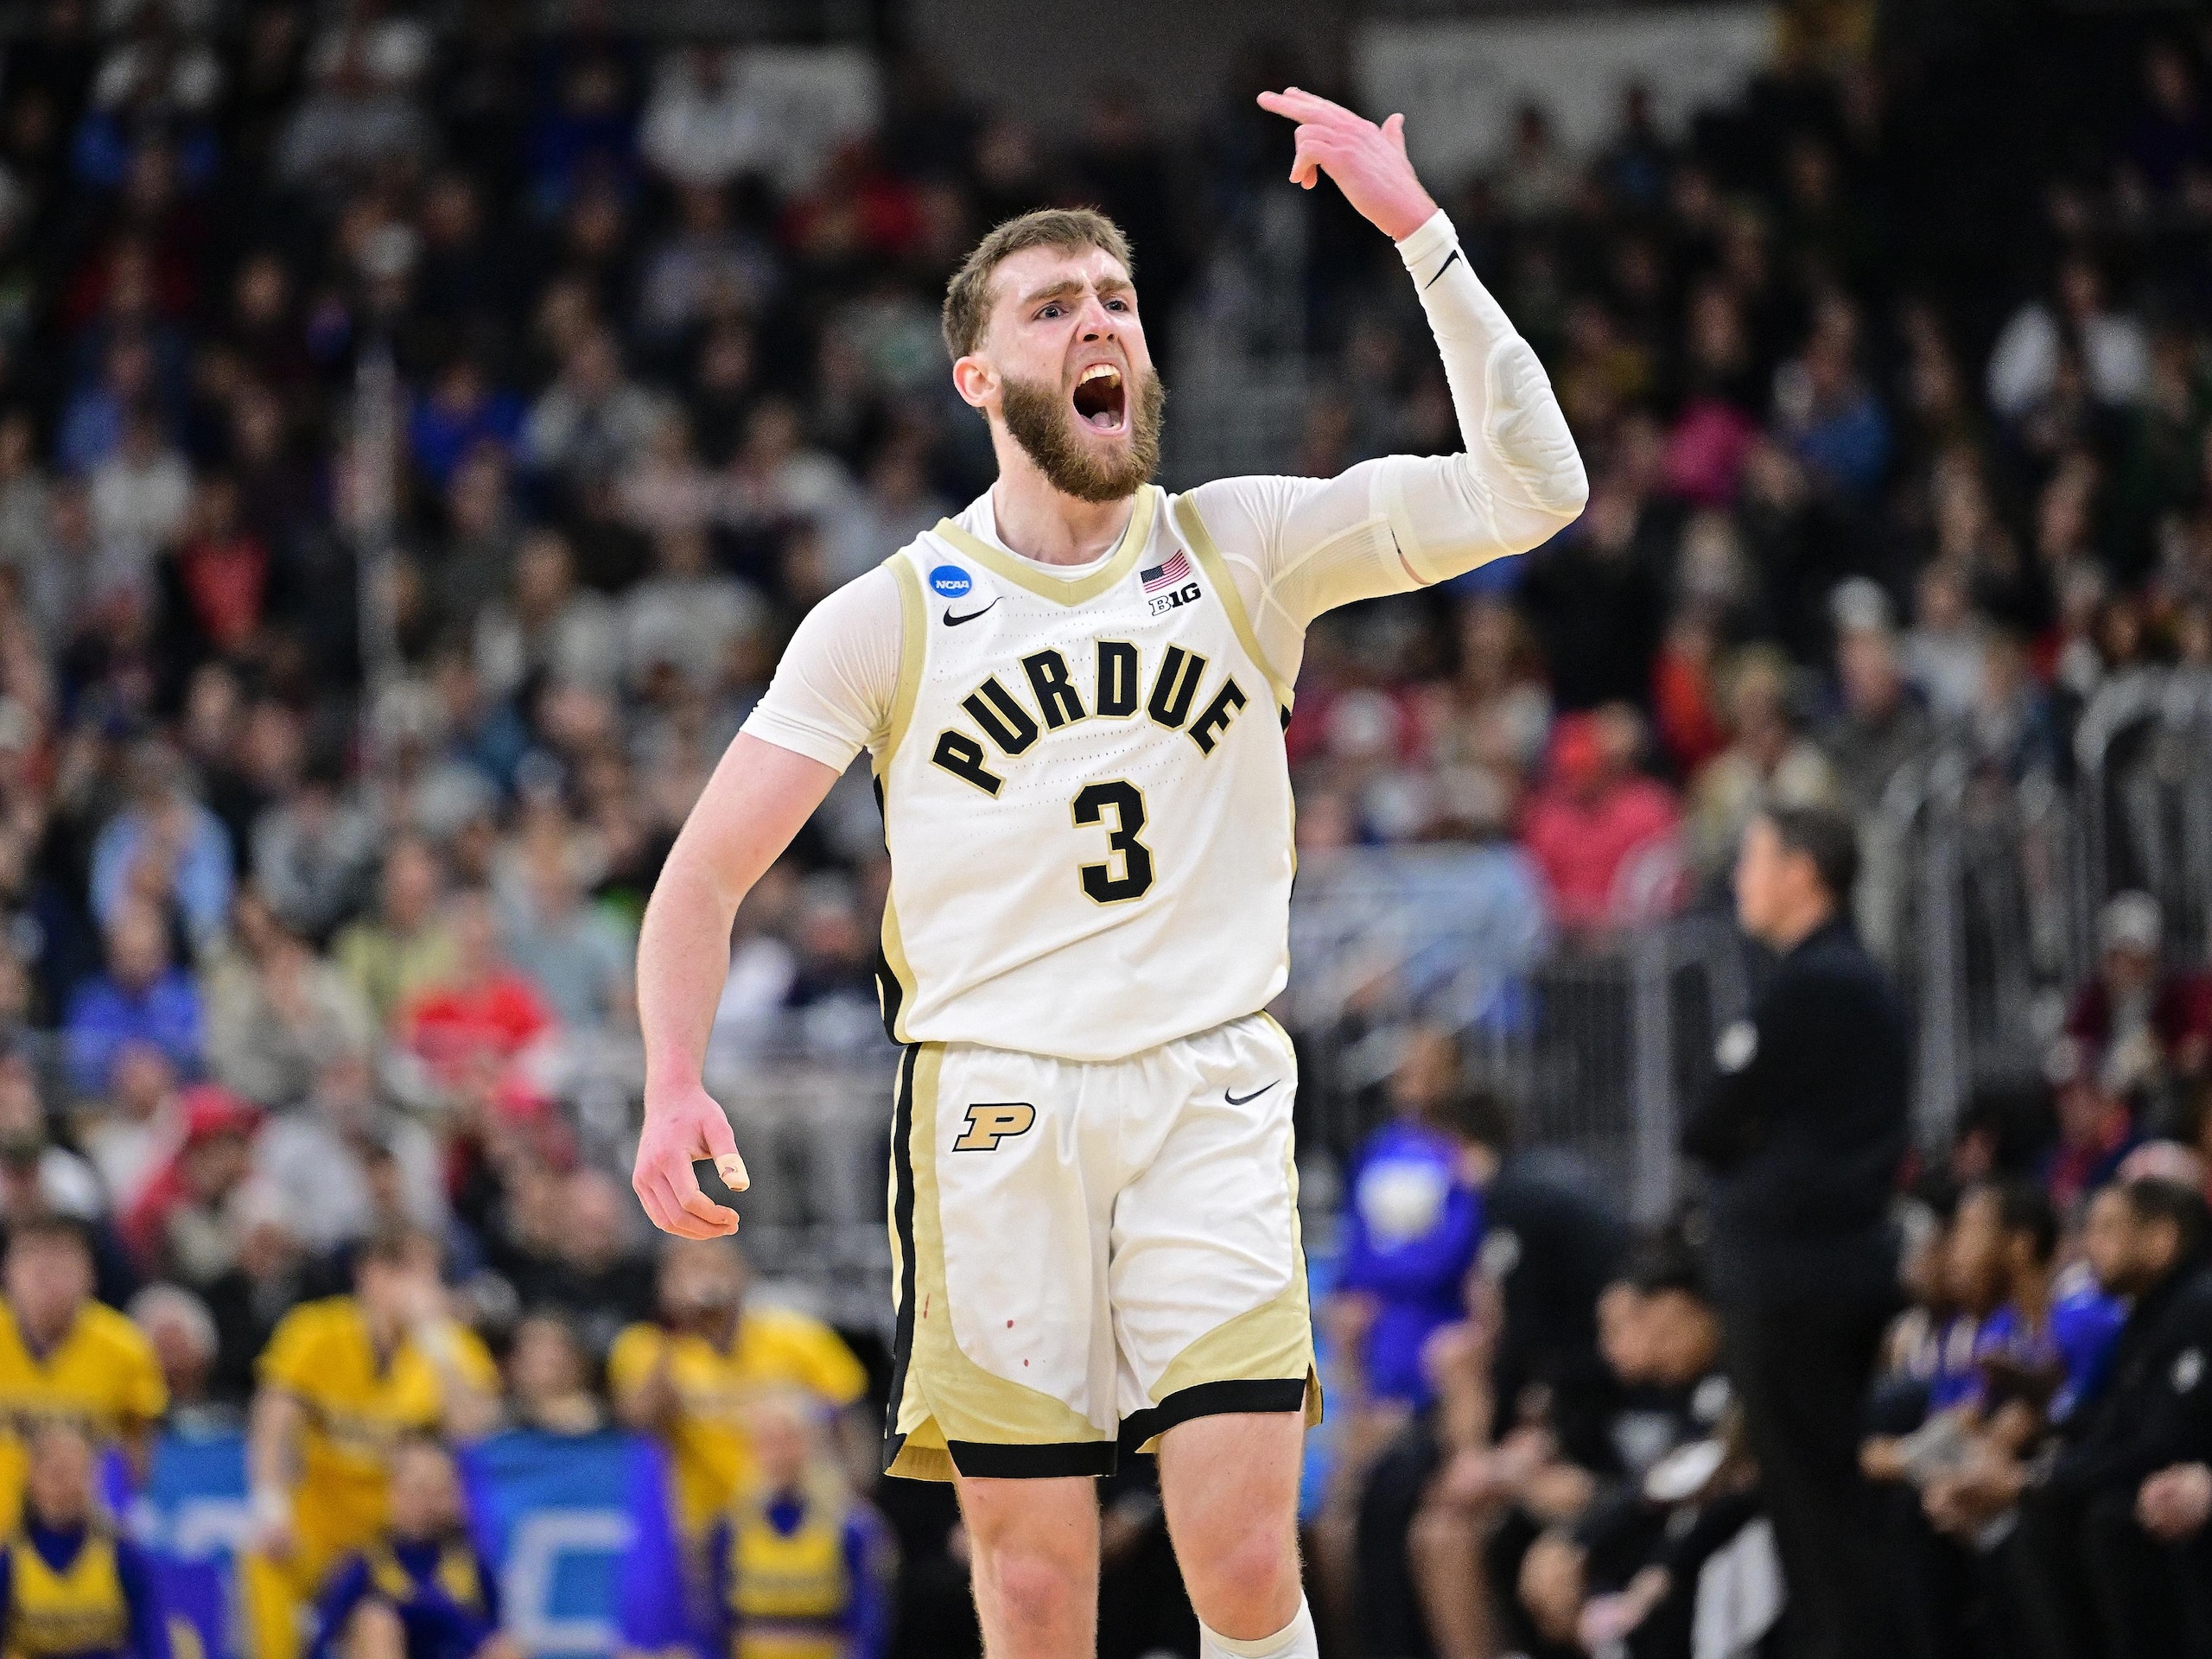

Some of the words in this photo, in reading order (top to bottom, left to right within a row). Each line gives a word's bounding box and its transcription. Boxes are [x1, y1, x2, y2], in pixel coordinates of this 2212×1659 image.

[935, 580, 970, 589] NCAA
[930, 637, 1250, 799] PURDUE
[1070, 778, 1156, 907] 3
[951, 1102, 1037, 1153] P
